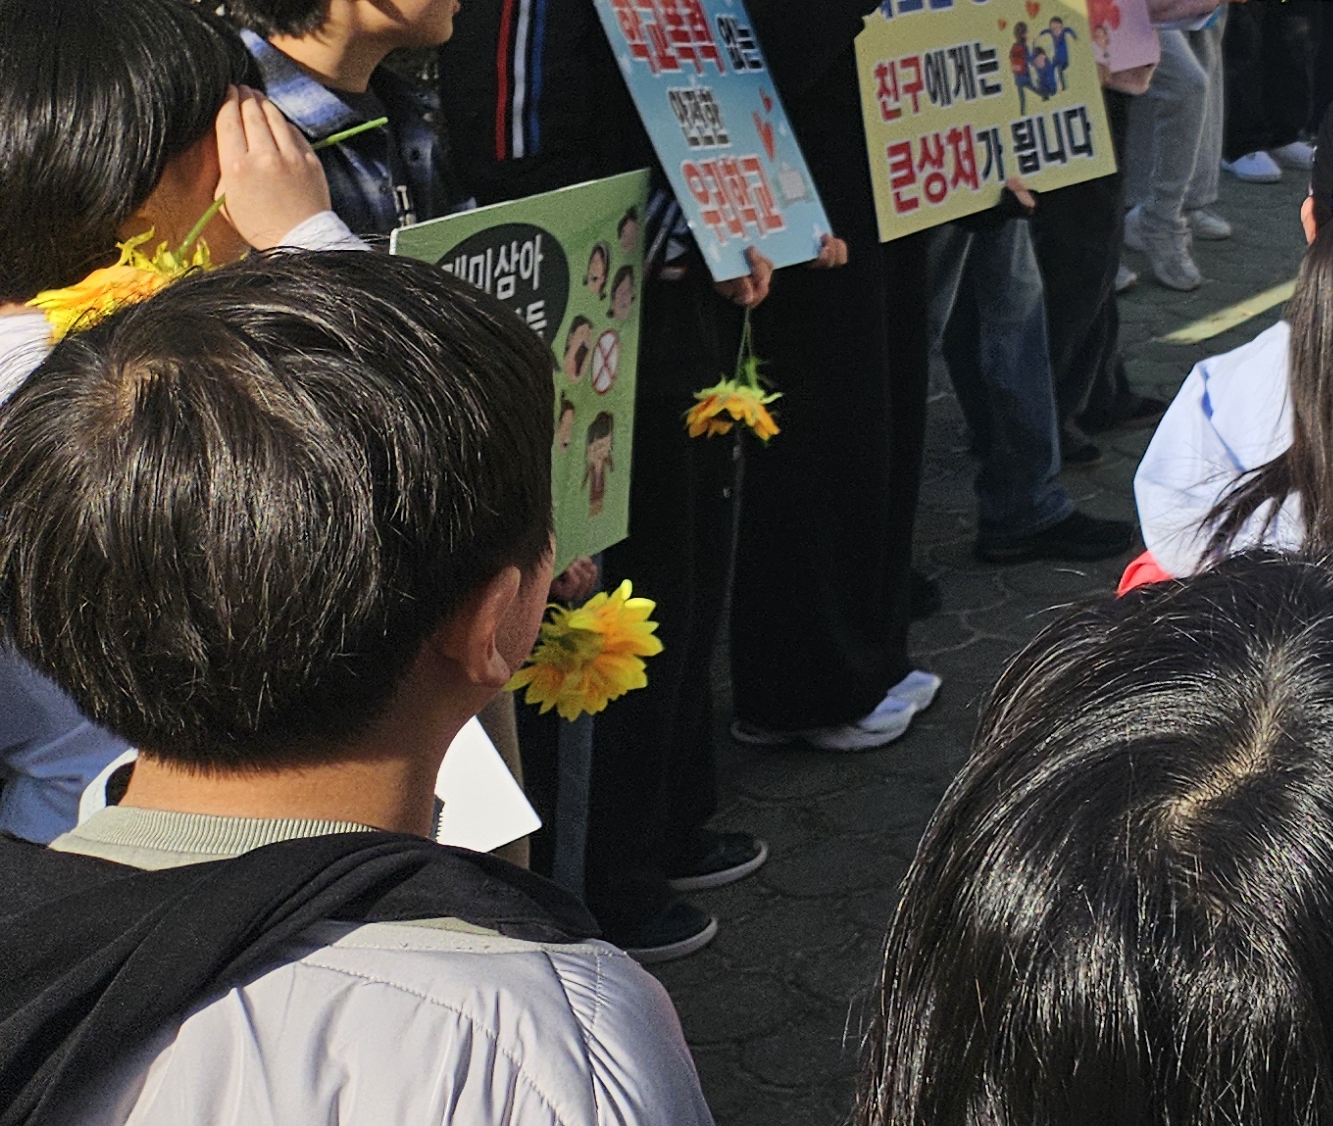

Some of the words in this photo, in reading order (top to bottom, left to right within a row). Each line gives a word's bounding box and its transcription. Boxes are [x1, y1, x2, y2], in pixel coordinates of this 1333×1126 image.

[715, 14, 766, 74] 없는
[873, 41, 1002, 123] 친구에게는
[666, 86, 733, 149] 안전한
[681, 155, 787, 246] 우리학교
[886, 126, 1005, 215] 큰상처가
[1010, 105, 1094, 175] 됩니다
